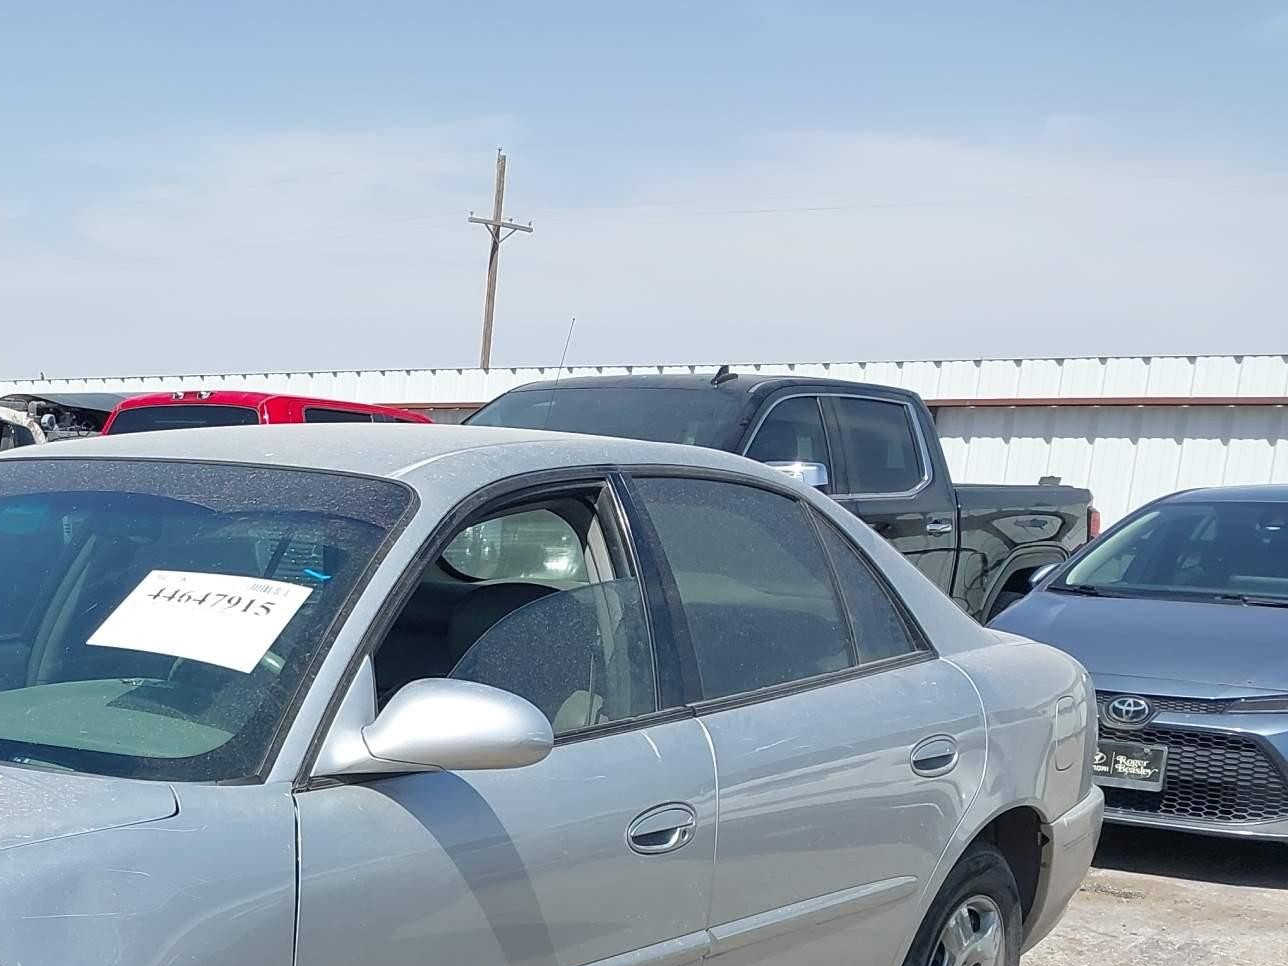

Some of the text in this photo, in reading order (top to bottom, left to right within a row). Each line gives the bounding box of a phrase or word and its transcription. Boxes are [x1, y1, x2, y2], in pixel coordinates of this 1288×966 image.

[147, 587, 276, 616] 44647915
[1115, 755, 1150, 768] Roger
[1114, 763, 1159, 777] Beasley
